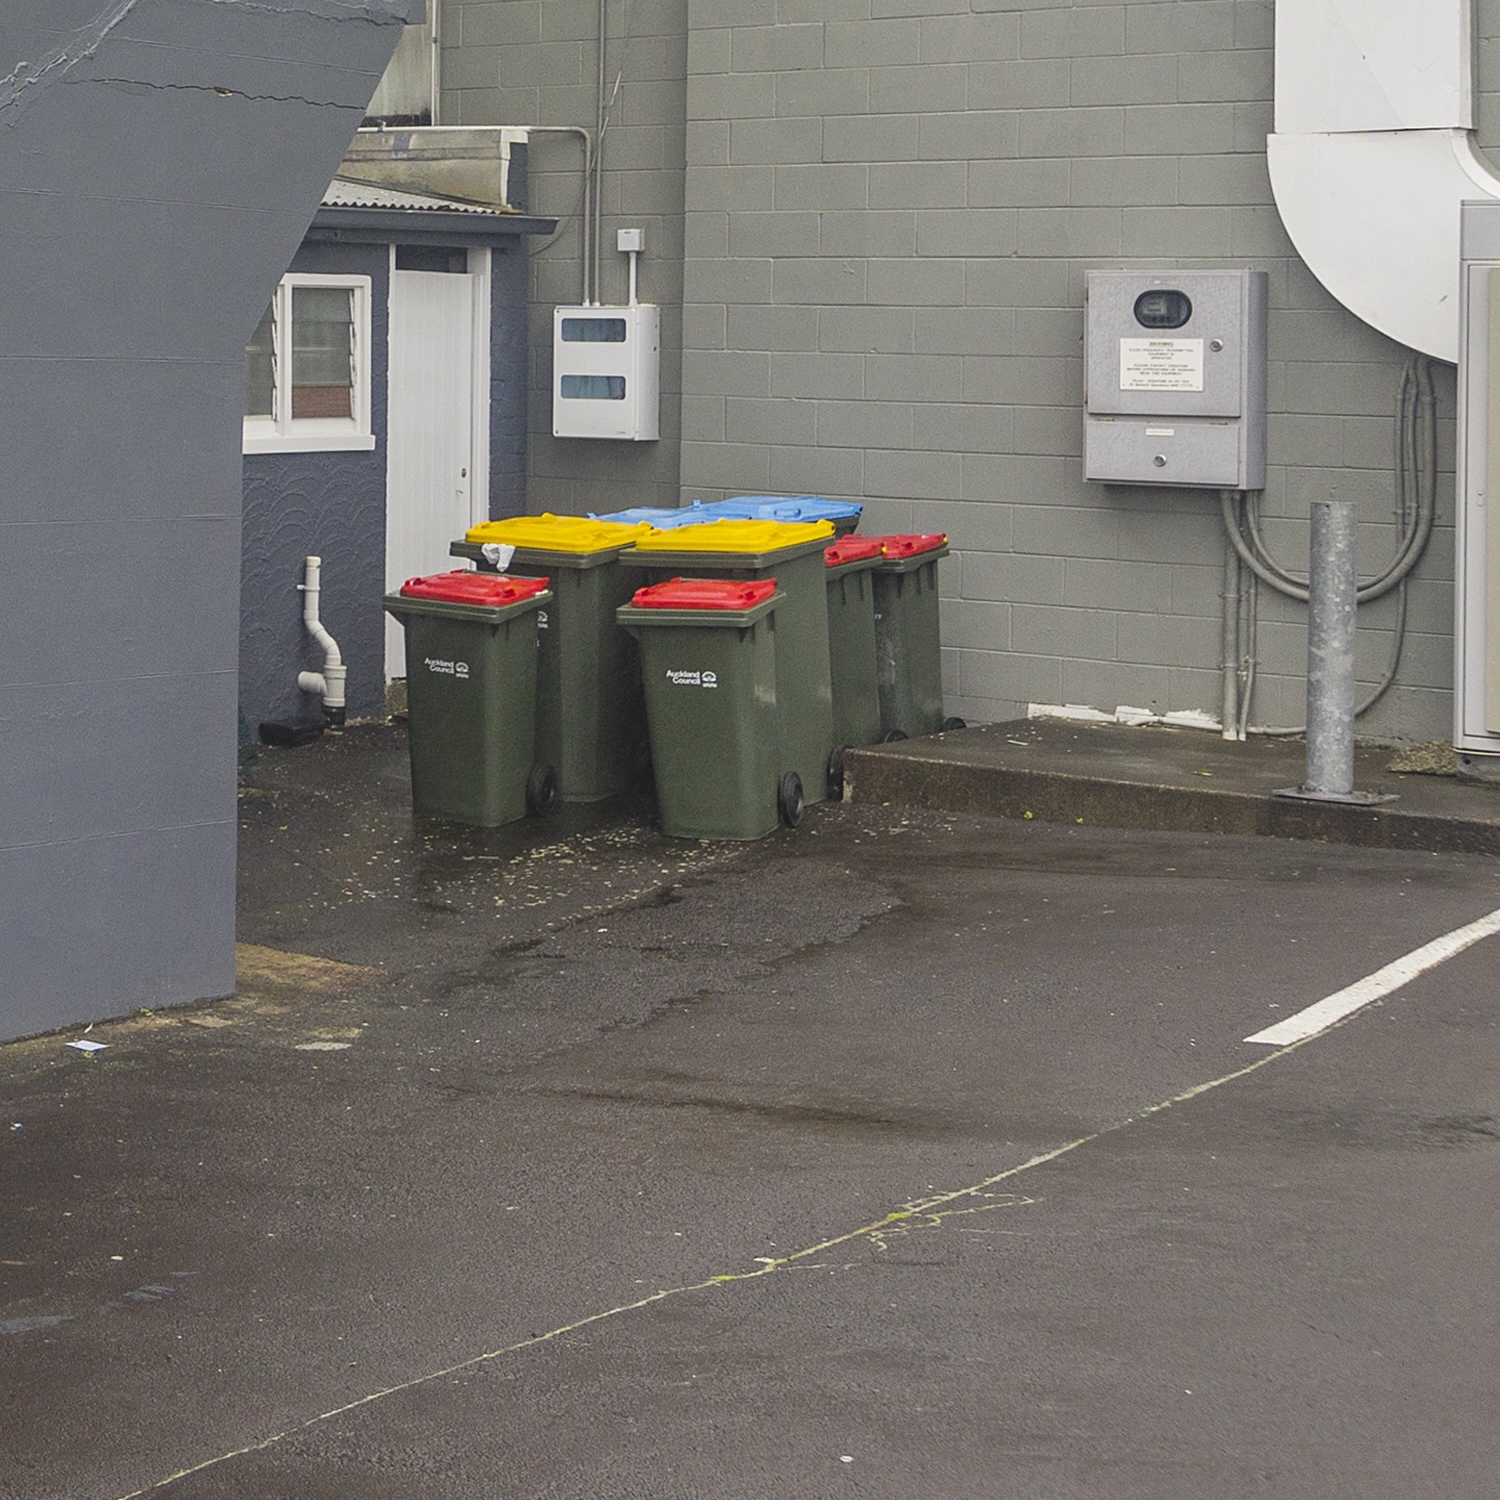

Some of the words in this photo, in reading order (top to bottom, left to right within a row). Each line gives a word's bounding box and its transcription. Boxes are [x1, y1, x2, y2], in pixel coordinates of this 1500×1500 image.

[424, 657, 455, 668] Auckland
[429, 665, 455, 674] Council
[666, 669, 701, 678] Auckland
[672, 676, 701, 685] Council
